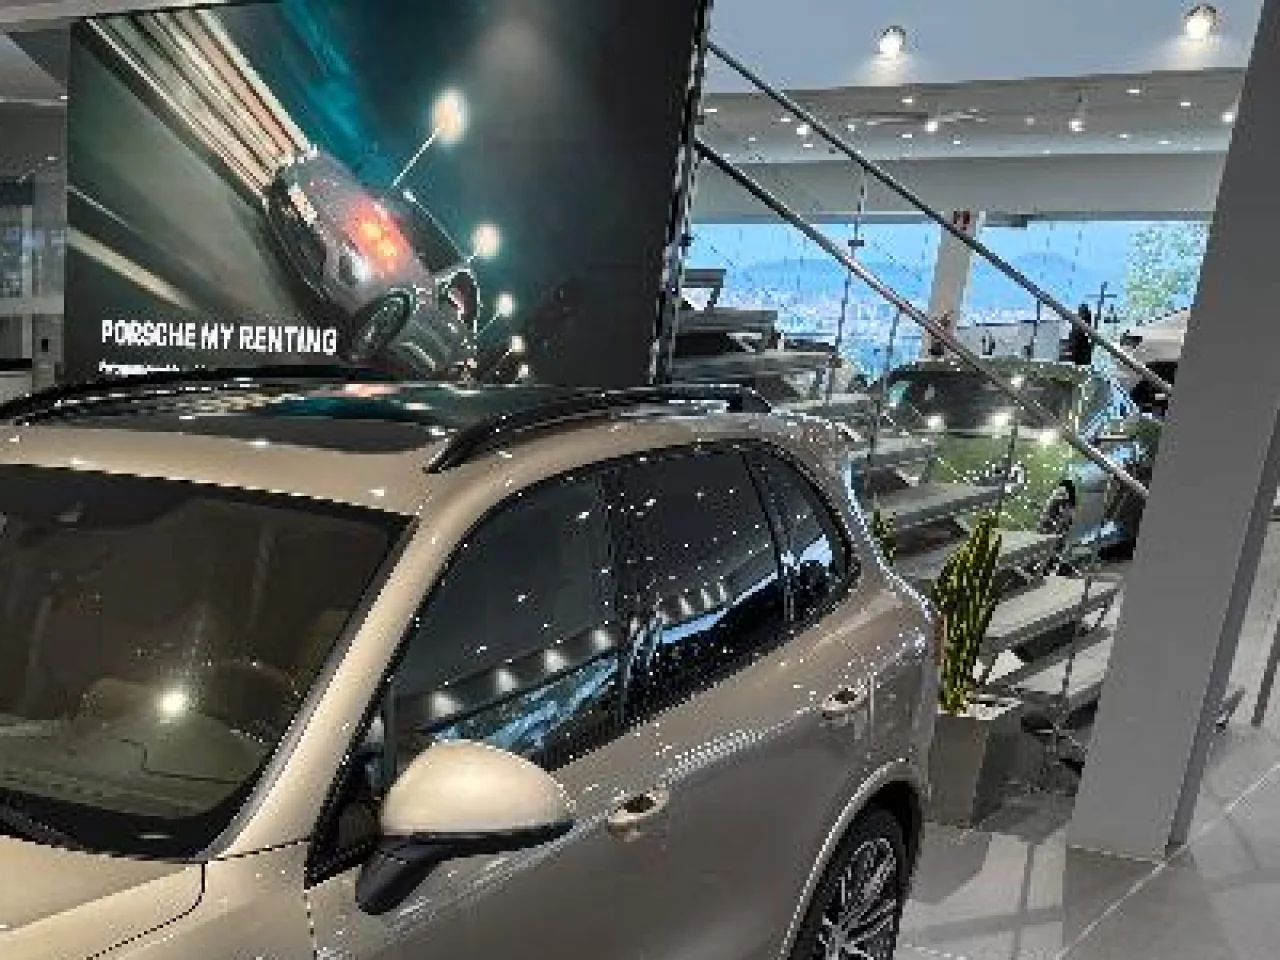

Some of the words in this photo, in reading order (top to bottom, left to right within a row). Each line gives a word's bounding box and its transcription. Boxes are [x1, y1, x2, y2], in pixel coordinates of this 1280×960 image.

[101, 319, 196, 348] PORSCHE
[201, 322, 234, 350] MY
[239, 325, 337, 355] RENTING
